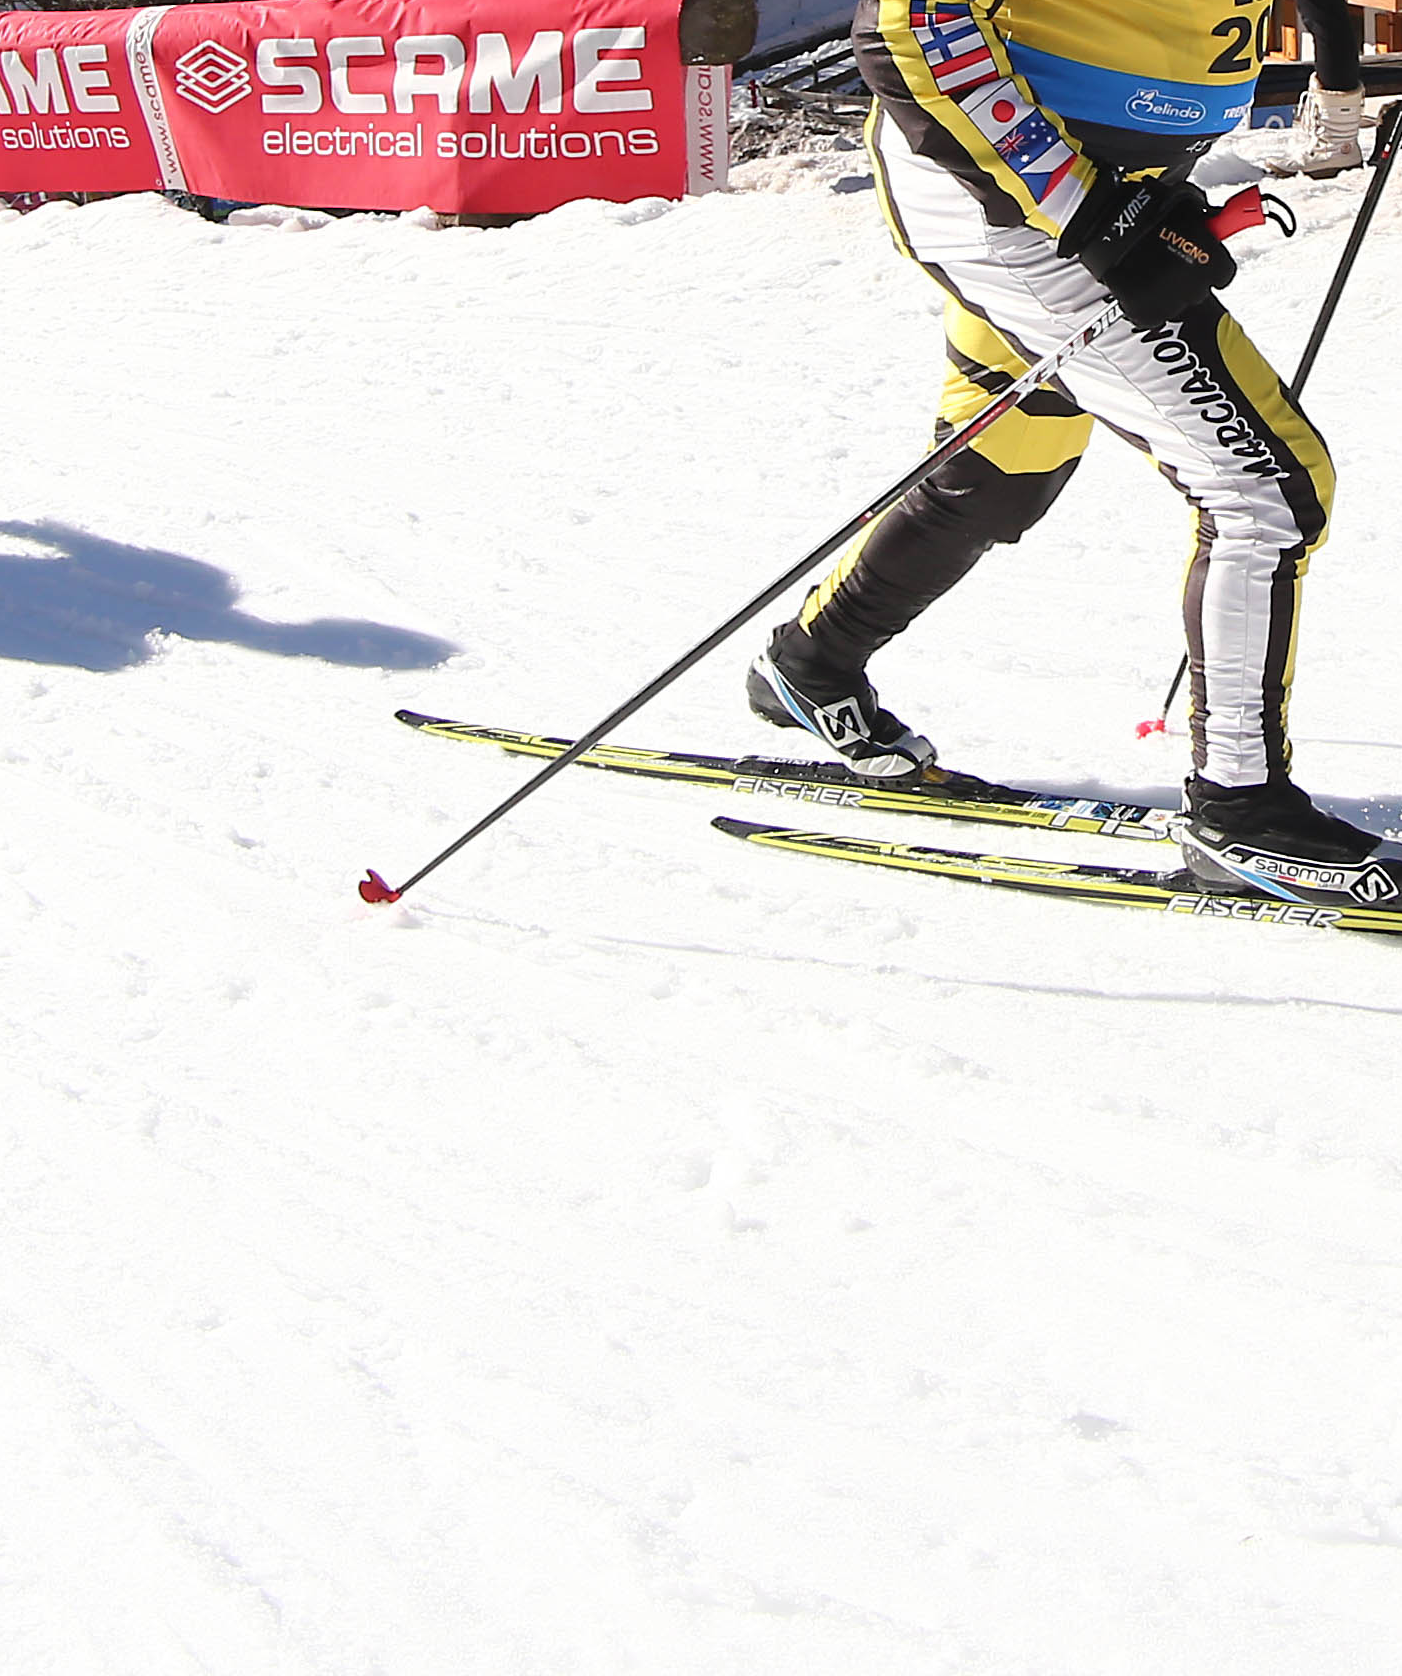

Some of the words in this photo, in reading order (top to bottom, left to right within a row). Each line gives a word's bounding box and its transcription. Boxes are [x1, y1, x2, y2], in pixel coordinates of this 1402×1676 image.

[257, 27, 655, 116] SCAME
[1131, 98, 1201, 120] Melinda
[2, 122, 131, 152] solutions
[262, 122, 423, 158] electrical
[437, 124, 660, 159] solutions
[1159, 226, 1210, 266] LIVIGNO
[1131, 320, 1291, 480] MARCIALON
[731, 776, 865, 809] FISCHER
[1166, 894, 1344, 931] FISCHER
